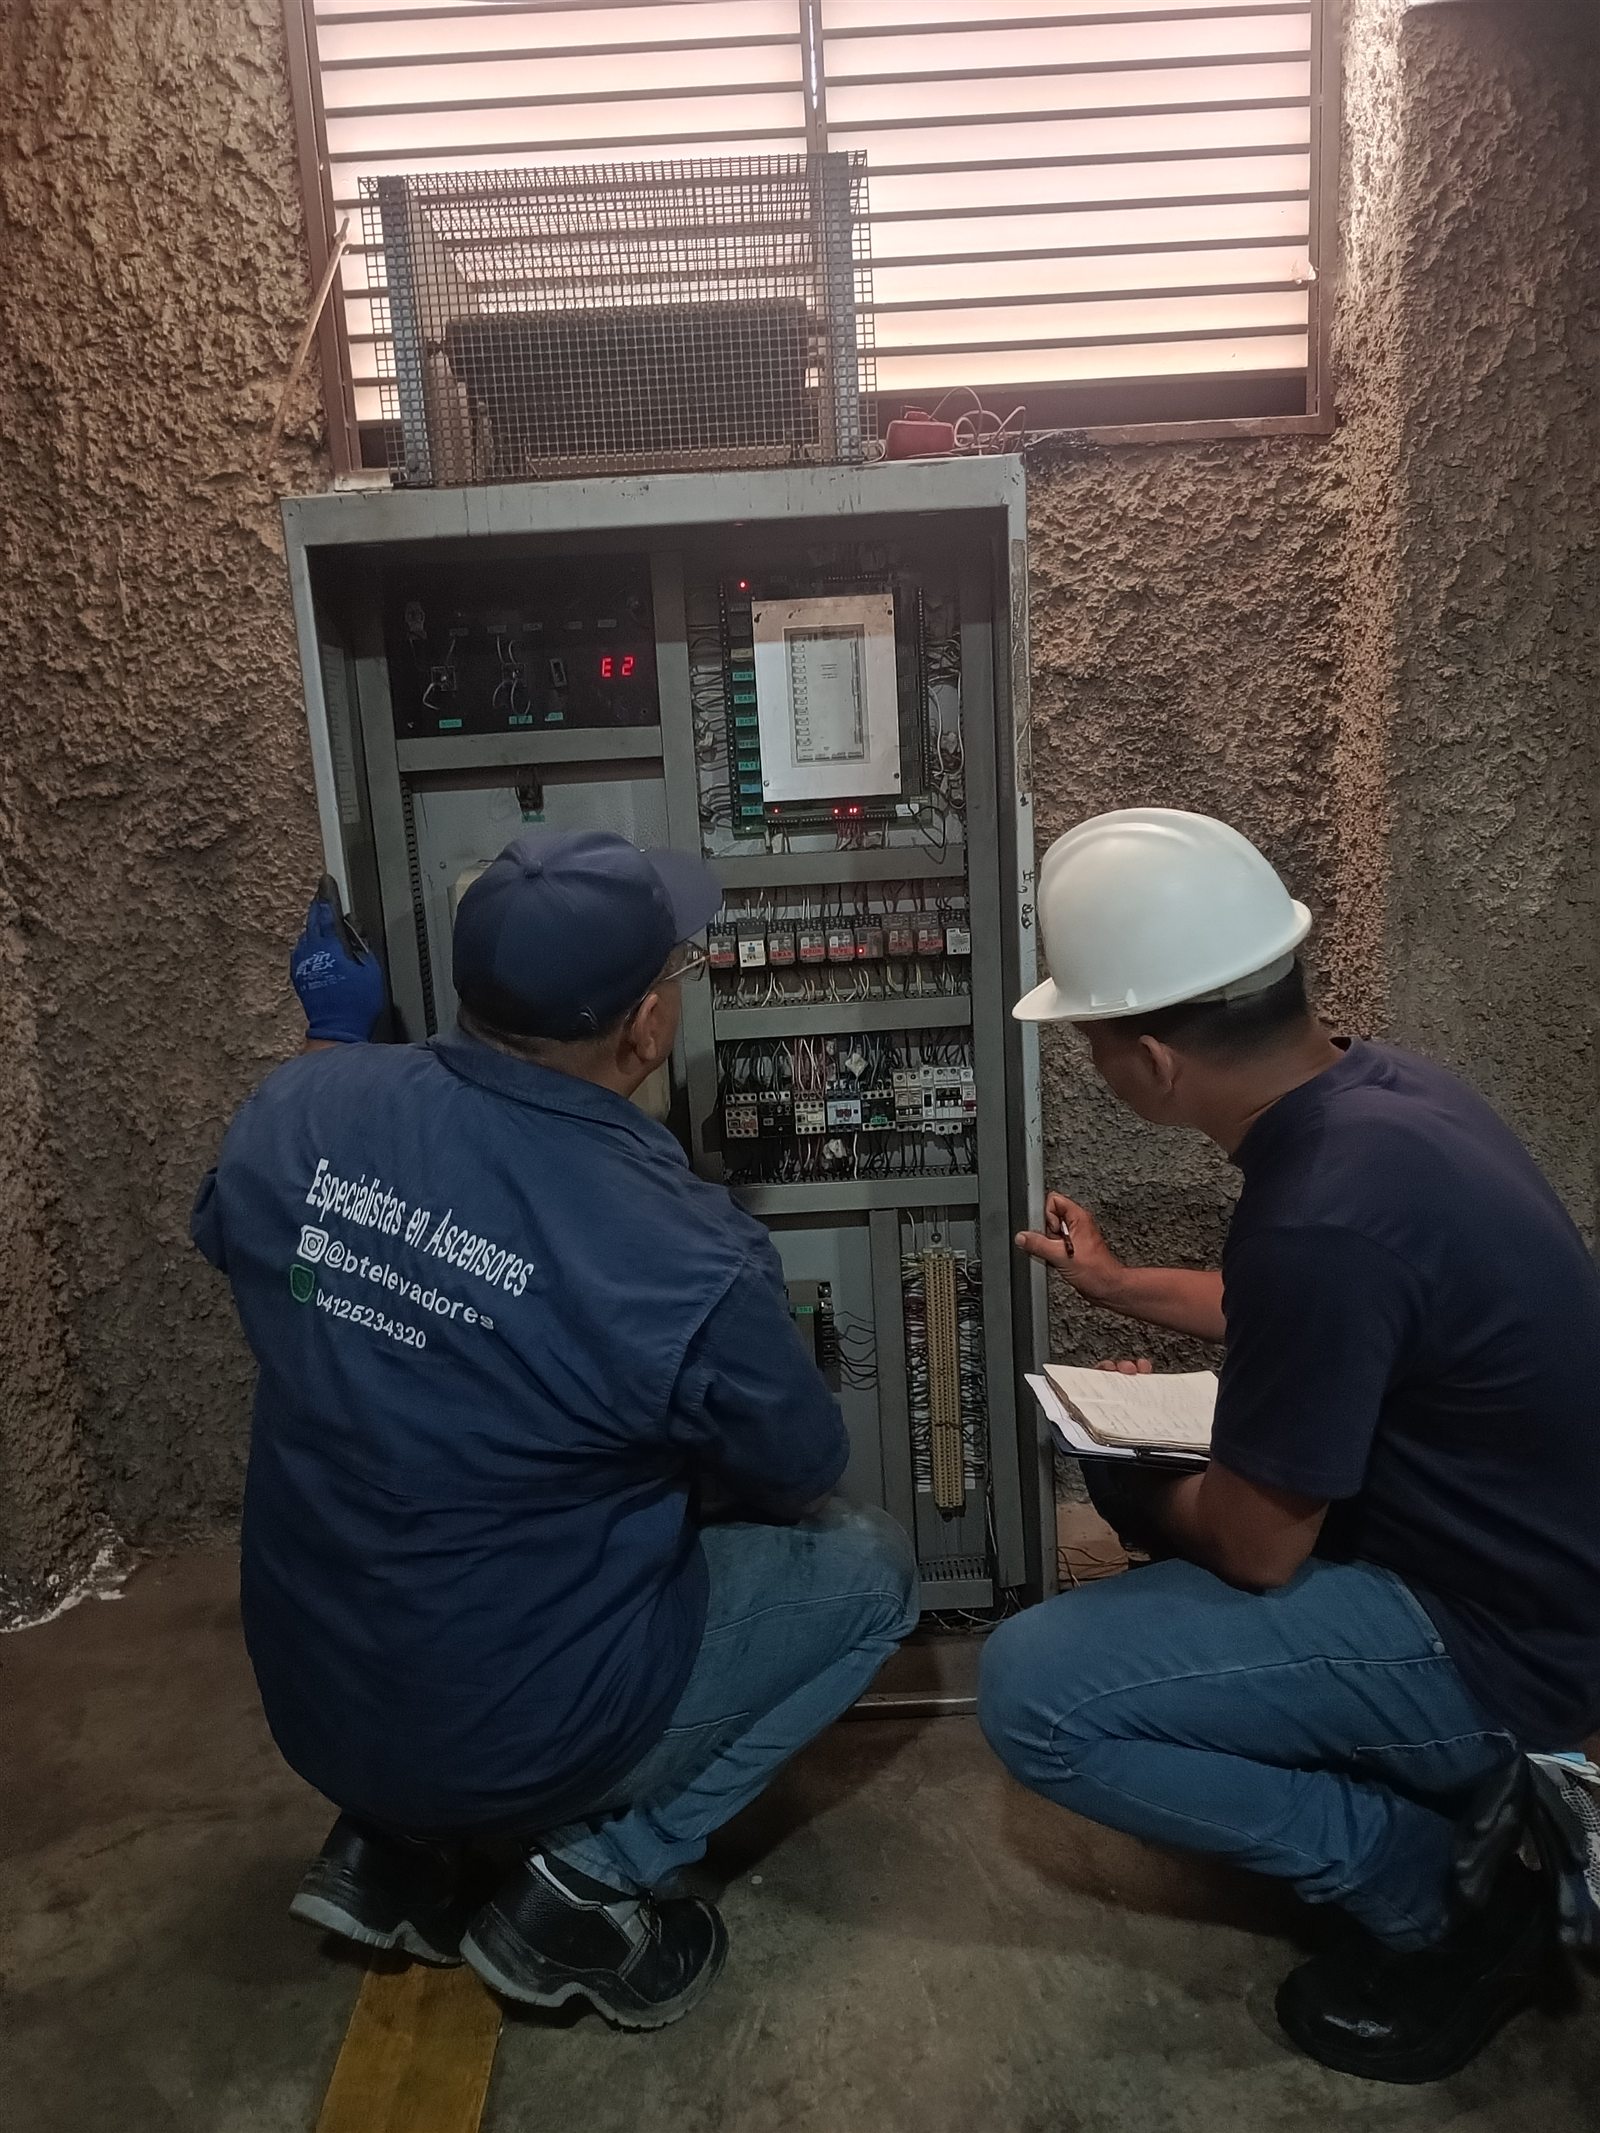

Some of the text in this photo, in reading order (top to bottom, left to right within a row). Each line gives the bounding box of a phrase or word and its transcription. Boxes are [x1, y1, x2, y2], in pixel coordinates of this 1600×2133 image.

[306, 1158, 535, 1297] Especialistas en Ascensores
[315, 1288, 426, 1349] 04125234320
[324, 1240, 494, 1330] @btelevadores
